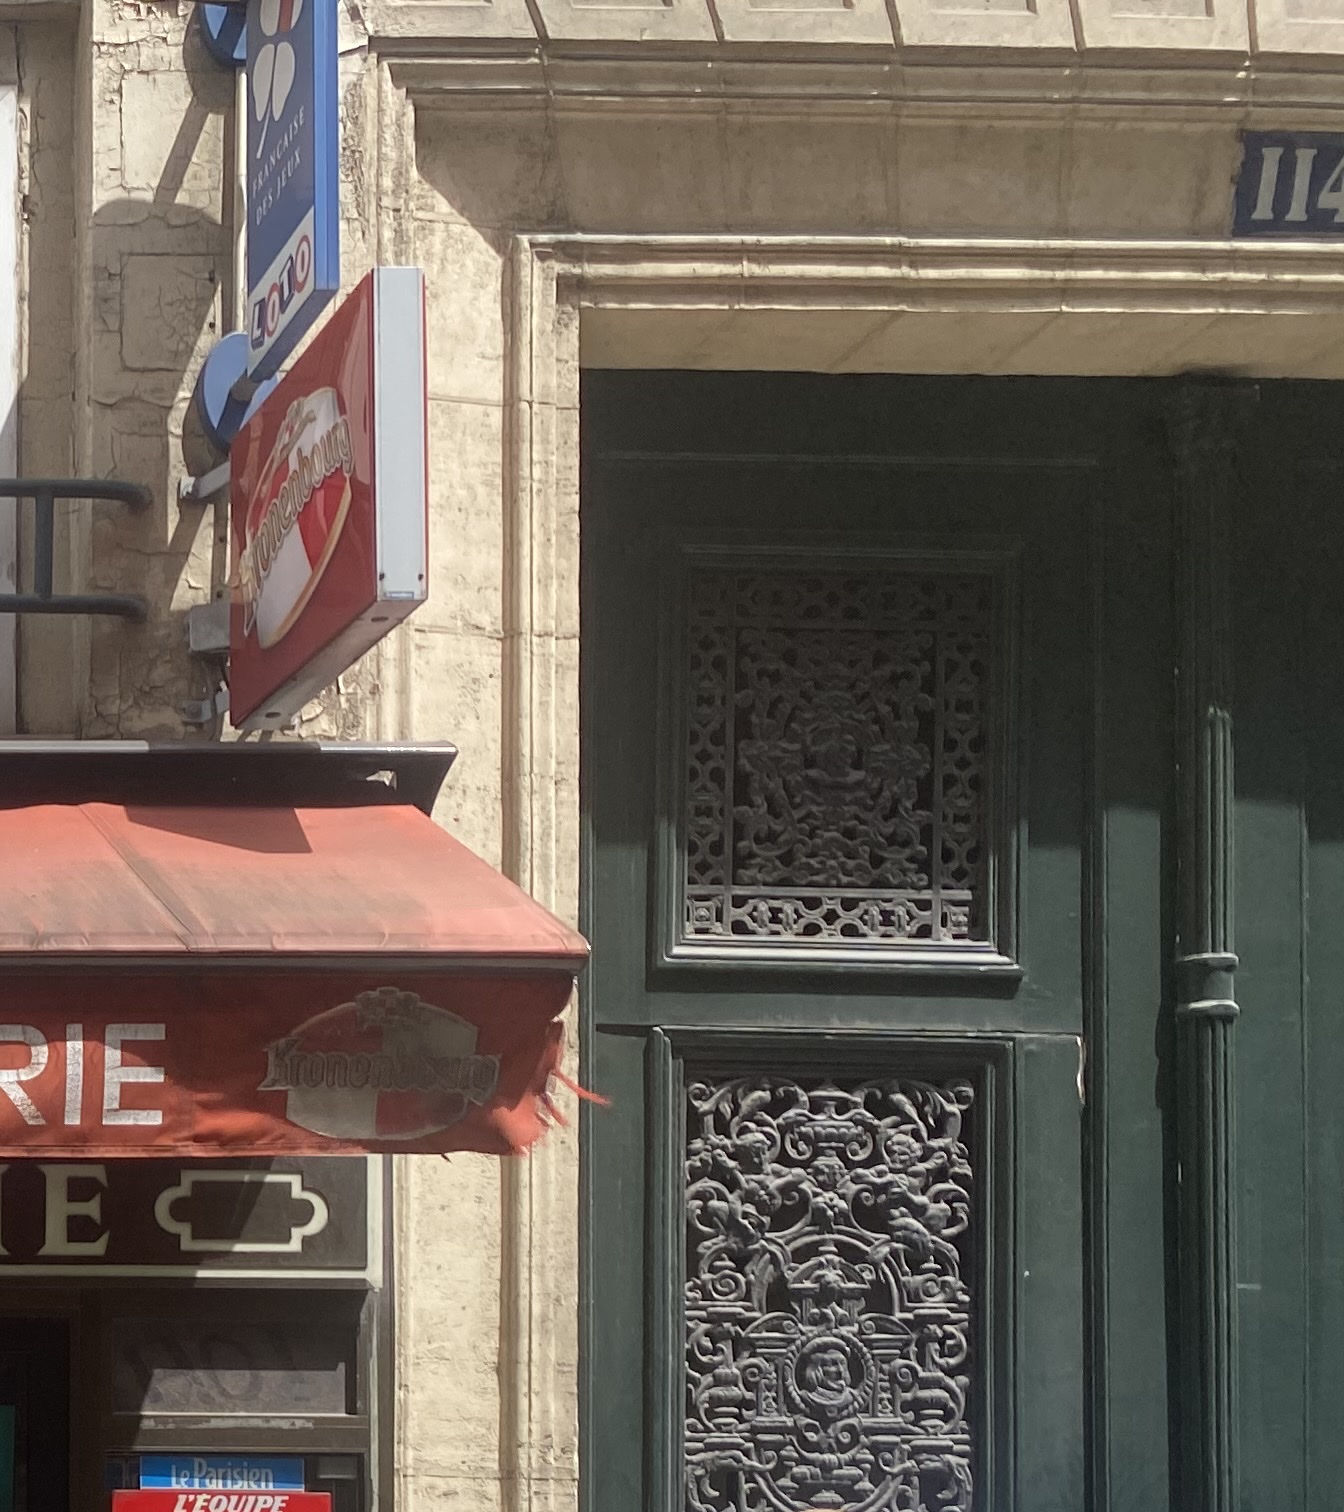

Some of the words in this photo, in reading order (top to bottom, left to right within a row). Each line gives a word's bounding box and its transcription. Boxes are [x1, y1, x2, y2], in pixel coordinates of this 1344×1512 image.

[256, 188, 274, 226] DES
[275, 146, 301, 200] JEUX
[1251, 146, 1344, 223] 114
[251, 234, 311, 351] LOTO
[171, 1465, 190, 1489] Le
[193, 1457, 274, 1490] Parisien
